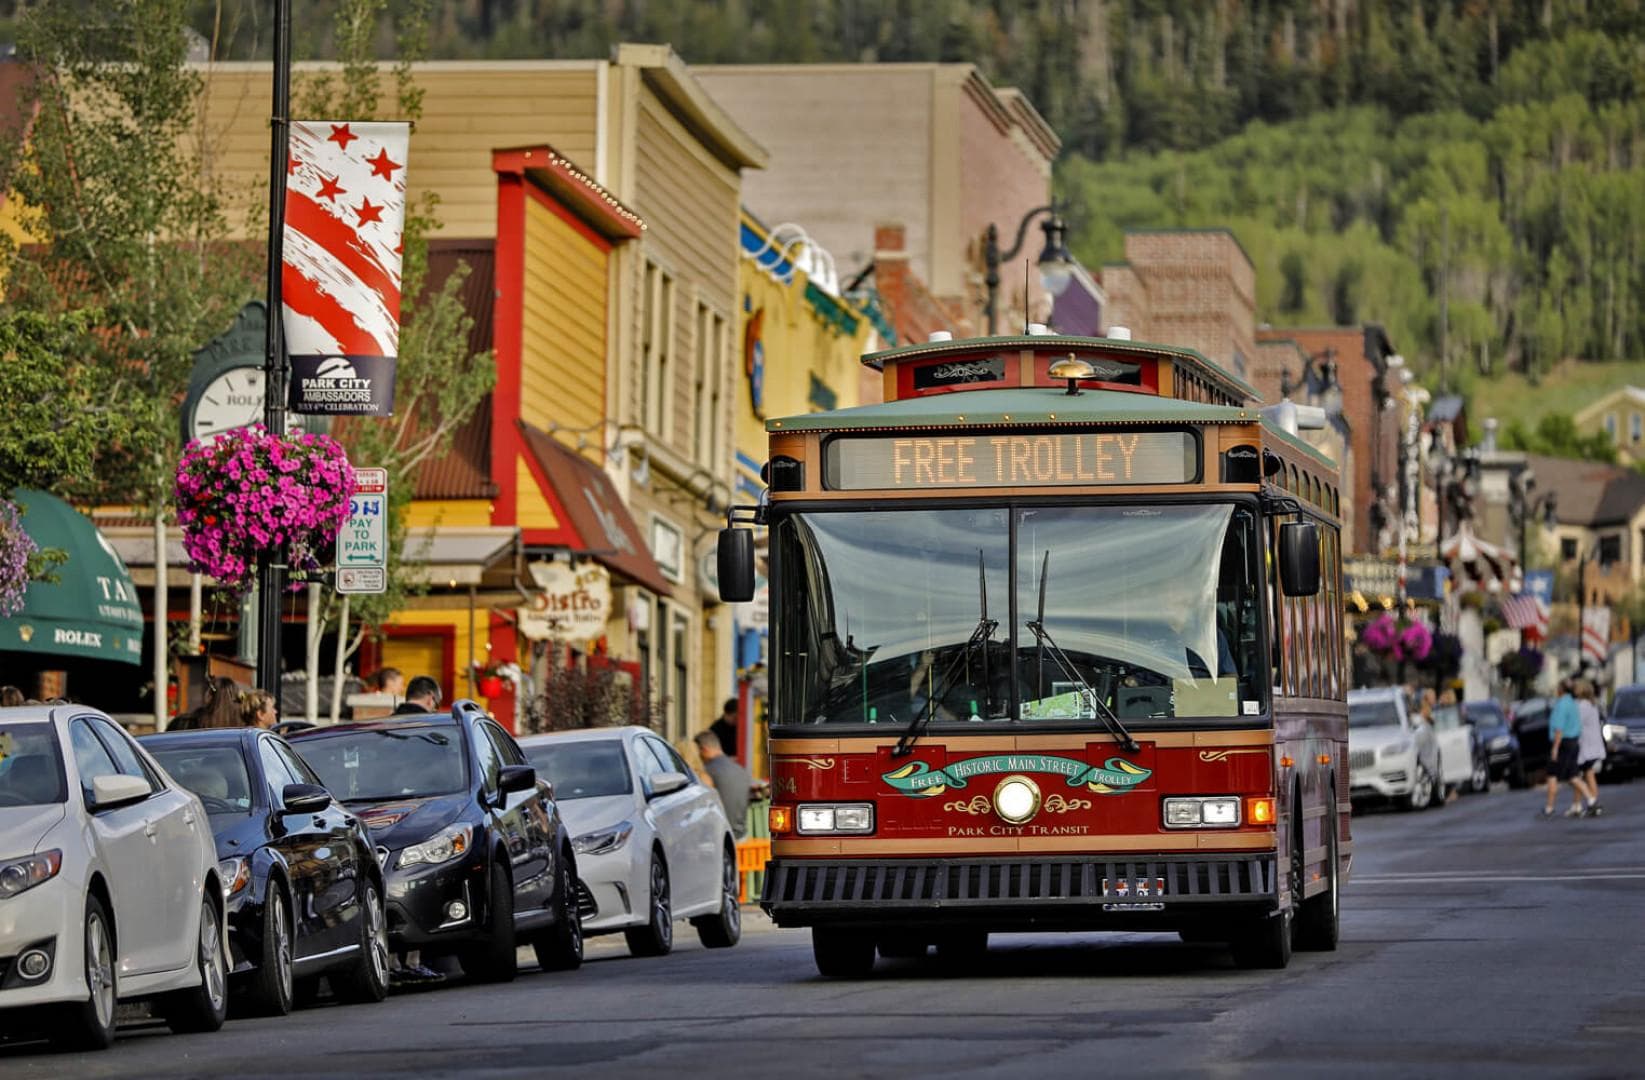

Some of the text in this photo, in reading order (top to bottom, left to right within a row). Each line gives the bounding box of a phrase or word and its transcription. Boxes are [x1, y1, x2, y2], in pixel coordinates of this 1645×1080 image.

[302, 378, 372, 389] PARK CITY
[303, 391, 371, 402] AMBASSADORS
[324, 402, 379, 411] CELEBRATION
[893, 434, 1139, 484] FREE TROLLEY
[349, 518, 372, 528] PAY
[353, 530, 370, 540] TO
[344, 542, 377, 552] PARK
[54, 628, 102, 648] ROLEX
[911, 756, 1133, 788] FREE HISTORIC MAIN STREET TROLLEY
[948, 825, 985, 836] PARK
[989, 824, 1025, 836] CITY
[1029, 824, 1090, 835] TRANSIT
